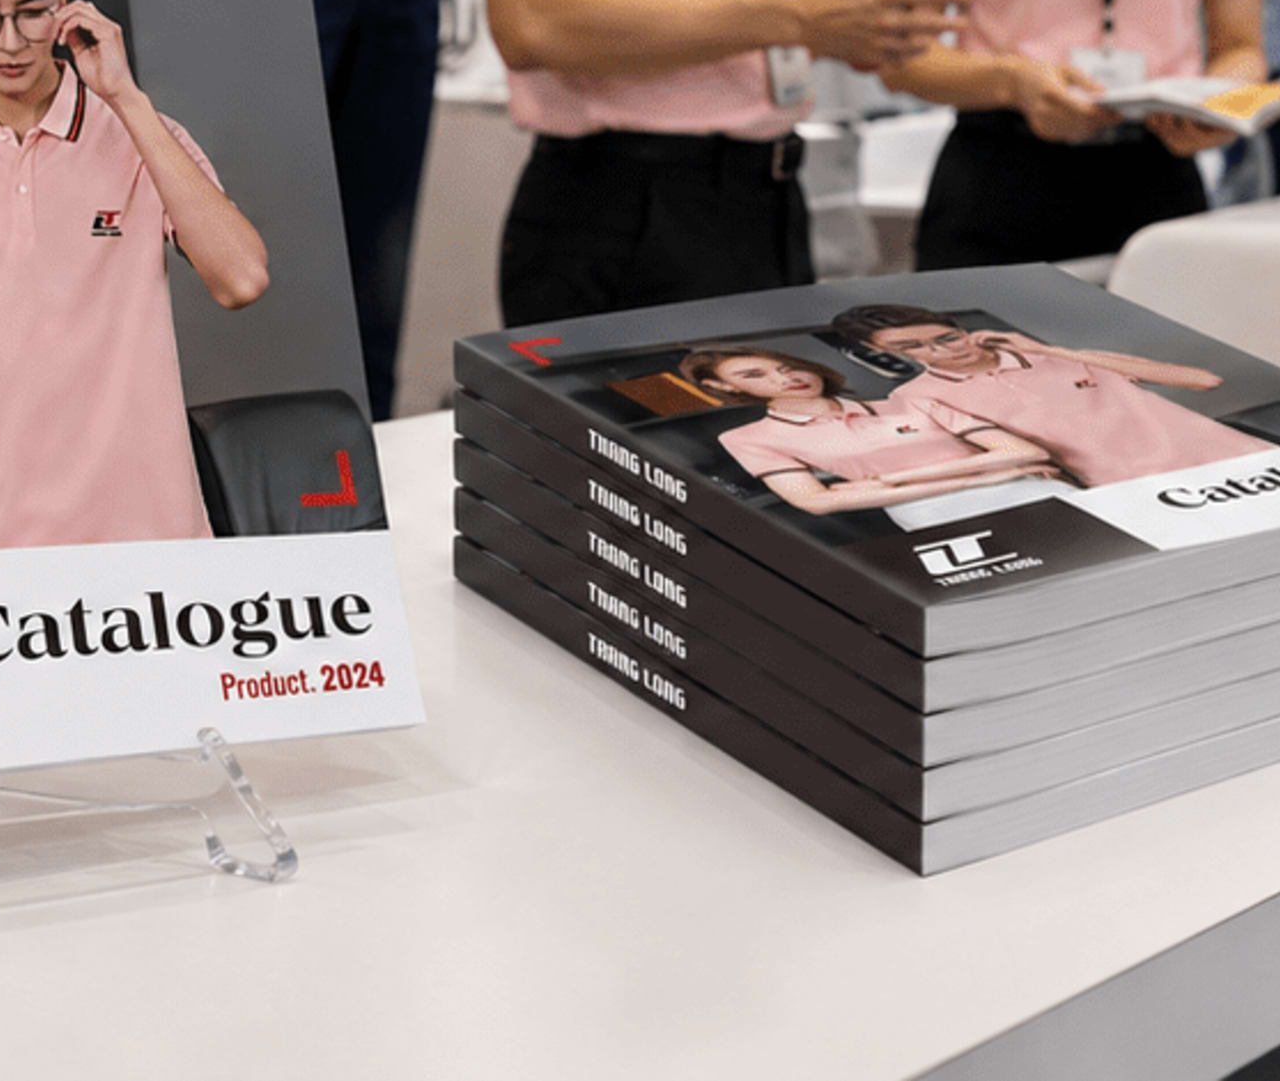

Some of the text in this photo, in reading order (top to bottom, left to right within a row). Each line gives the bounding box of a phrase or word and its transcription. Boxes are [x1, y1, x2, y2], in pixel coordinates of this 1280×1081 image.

[644, 460, 687, 504] LONG
[644, 512, 687, 556] LONG
[644, 563, 687, 609] LONG
[644, 615, 687, 660] LONG
[220, 660, 386, 701] Product. 2024
[643, 667, 686, 711] LONG
